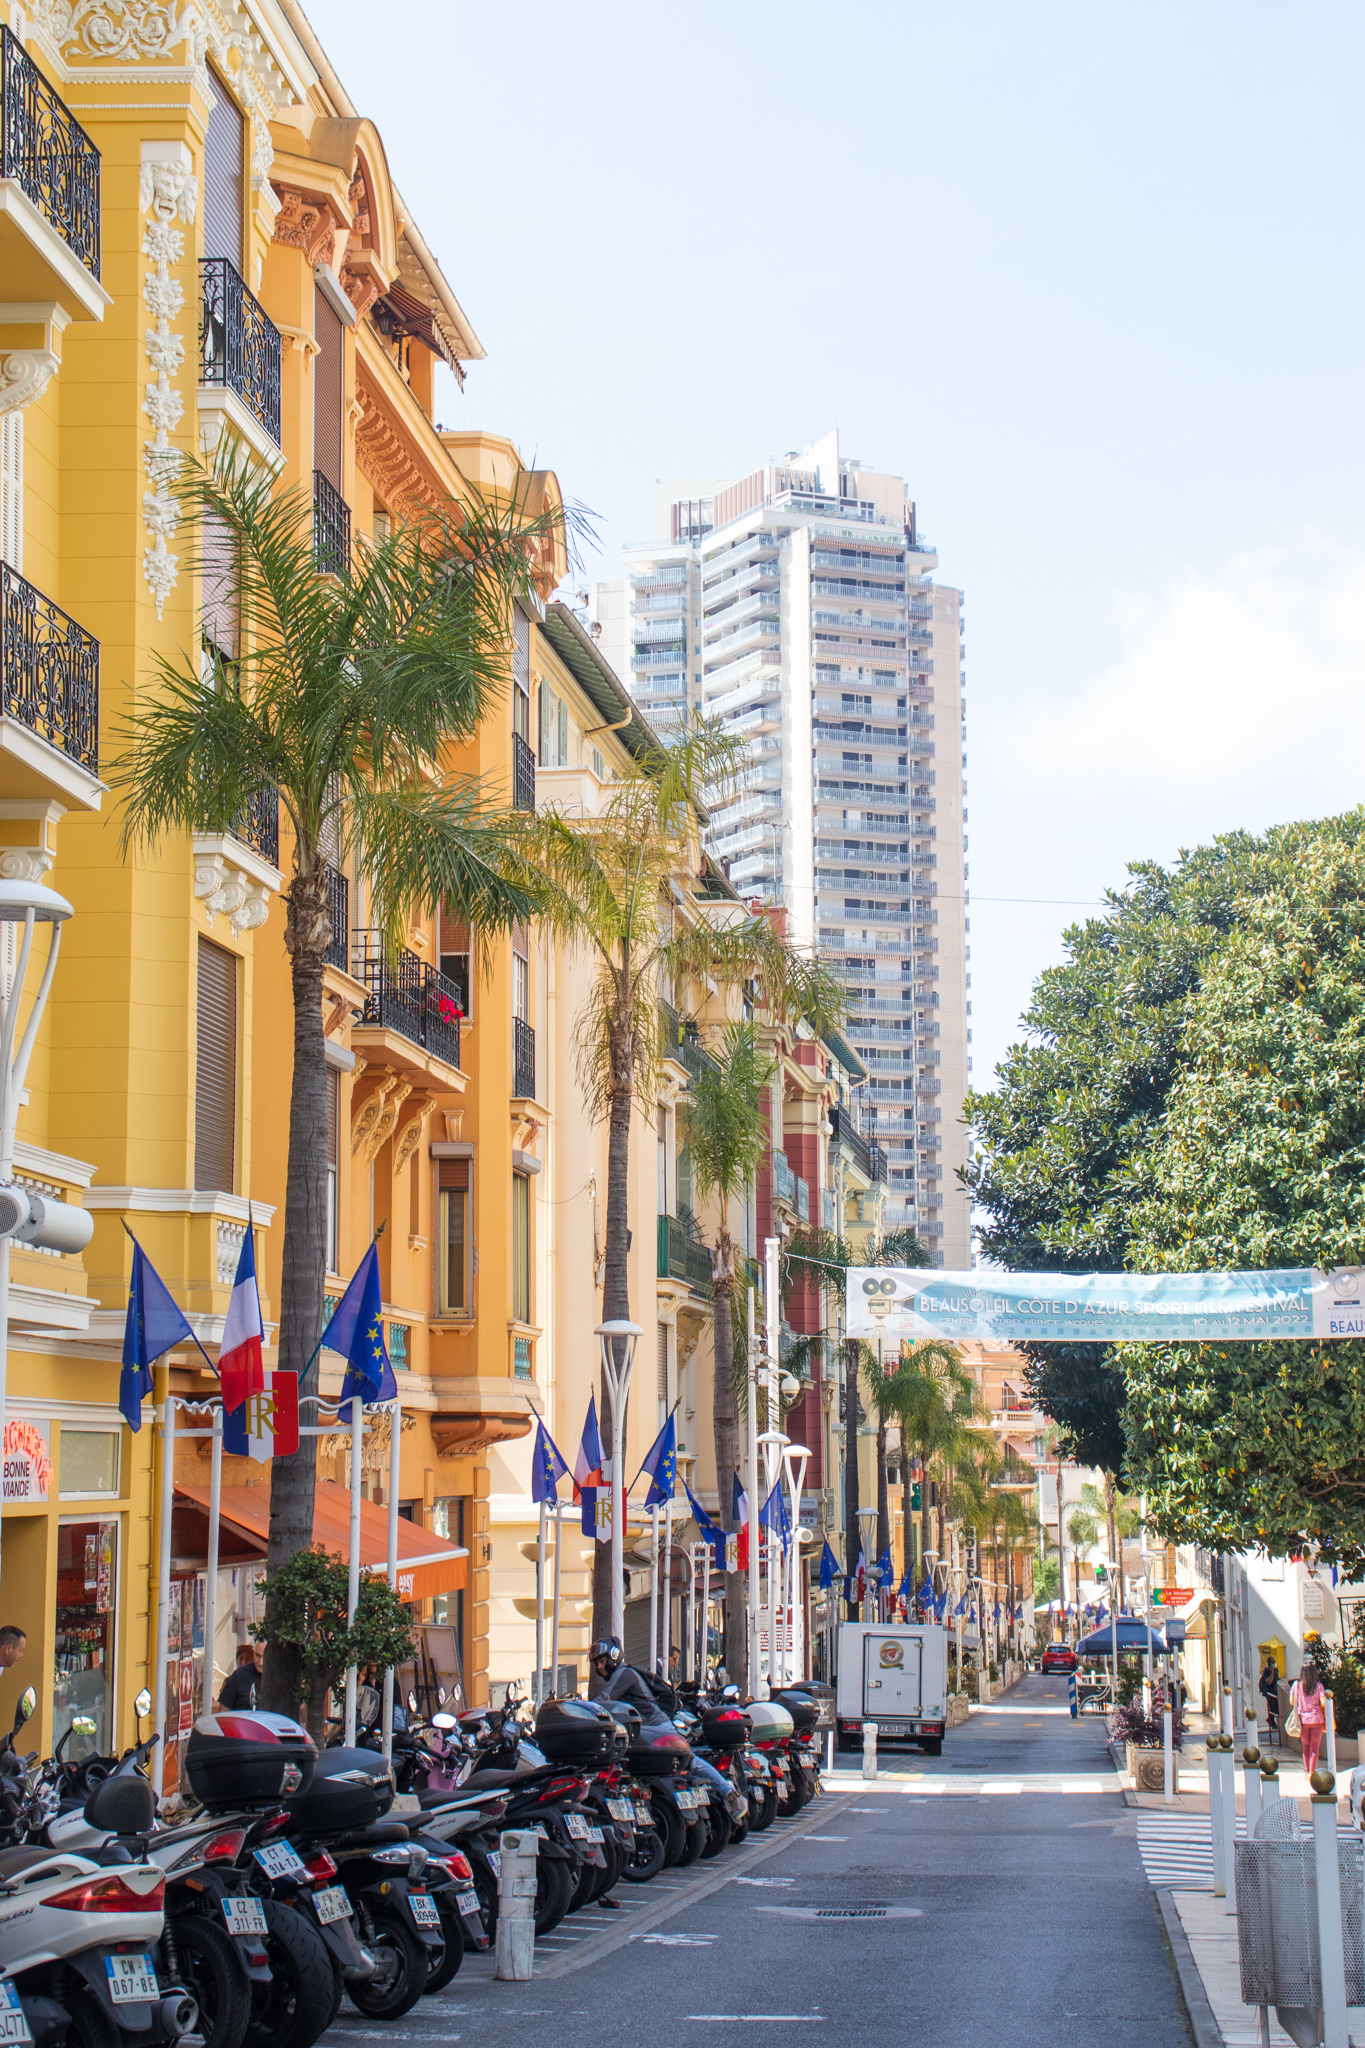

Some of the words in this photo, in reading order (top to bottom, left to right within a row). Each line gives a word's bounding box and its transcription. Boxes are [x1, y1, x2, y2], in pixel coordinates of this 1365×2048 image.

[920, 1296, 1013, 1314] BEAUSOLEIL
[1017, 1296, 1061, 1314] CÔTE
[1133, 1301, 1190, 1316] SPORT
[1194, 1300, 1233, 1315] FILM
[1236, 1296, 1309, 1314] FESTIVAL
[1193, 1317, 1208, 1326] 10
[1228, 1317, 1240, 1326] 12
[1243, 1316, 1270, 1325] MAI
[1273, 1314, 1309, 1324] 2022
[1330, 1320, 1365, 1334] BEAU
[4, 1461, 30, 1478] BONNE
[3, 1480, 30, 1497] VIANDE
[138, 1869, 160, 1877] SUZUKI
[236, 1900, 248, 1914] CZ
[234, 1917, 264, 1930] 311-FR
[121, 1959, 136, 1975] CN
[112, 1976, 156, 1995] 067-BE
